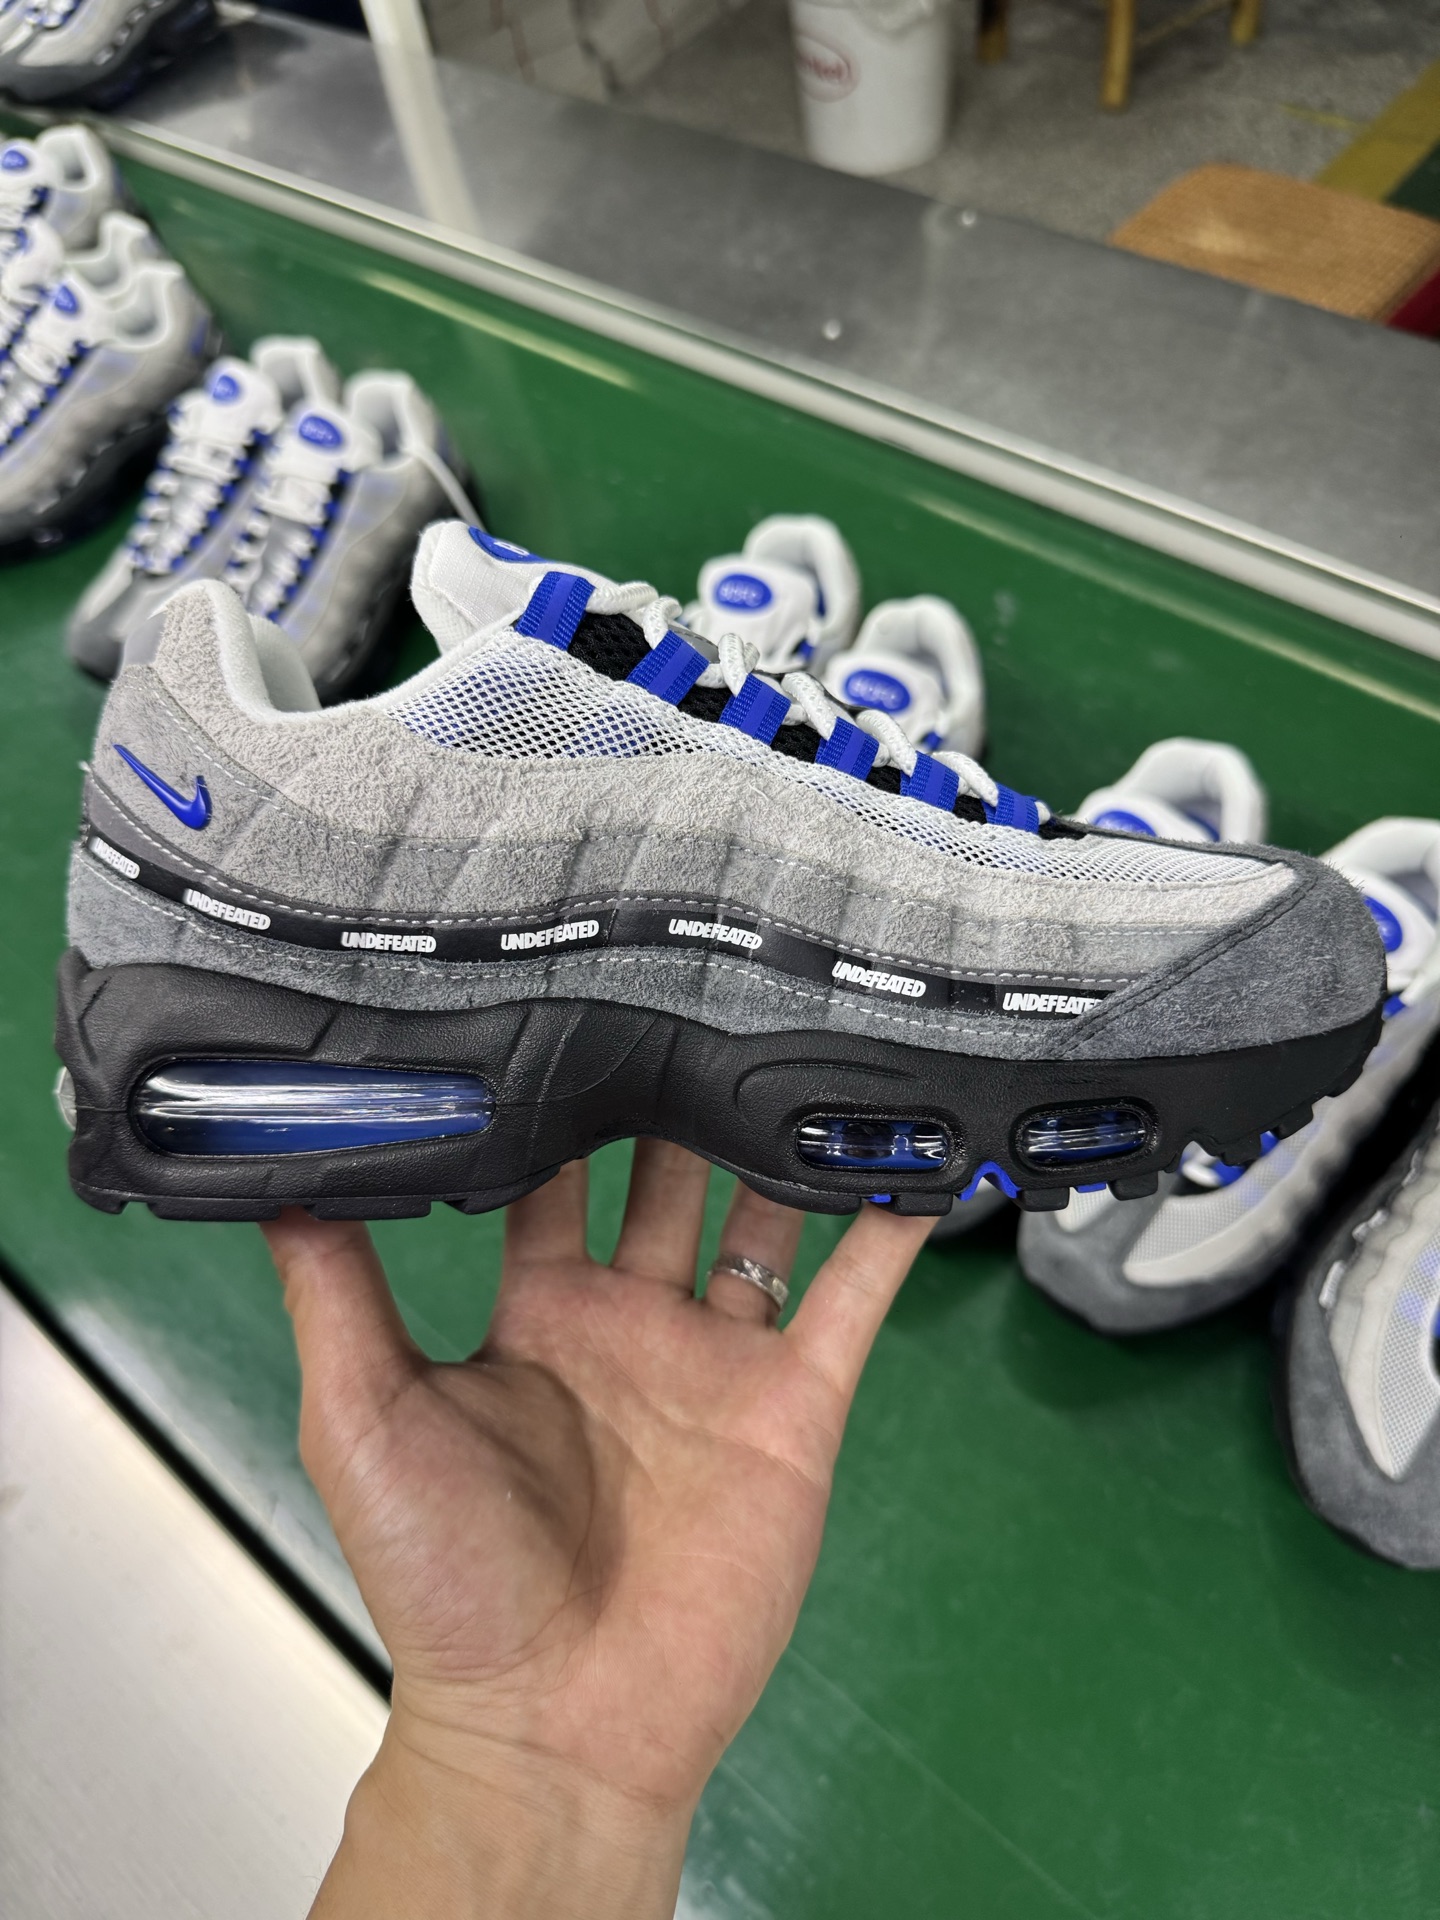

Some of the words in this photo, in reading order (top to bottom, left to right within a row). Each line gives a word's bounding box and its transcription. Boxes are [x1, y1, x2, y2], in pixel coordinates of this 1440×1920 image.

[90, 836, 140, 879] UNDEFEATED
[183, 888, 271, 930] UNDEFEATED
[341, 931, 437, 953] UNDEFEATED
[500, 919, 600, 951] UNDEFEATED
[668, 918, 763, 950] UNDEFEATED
[831, 960, 927, 998] UNDEFEATED
[1002, 992, 1103, 1015] UNDEFEATE
